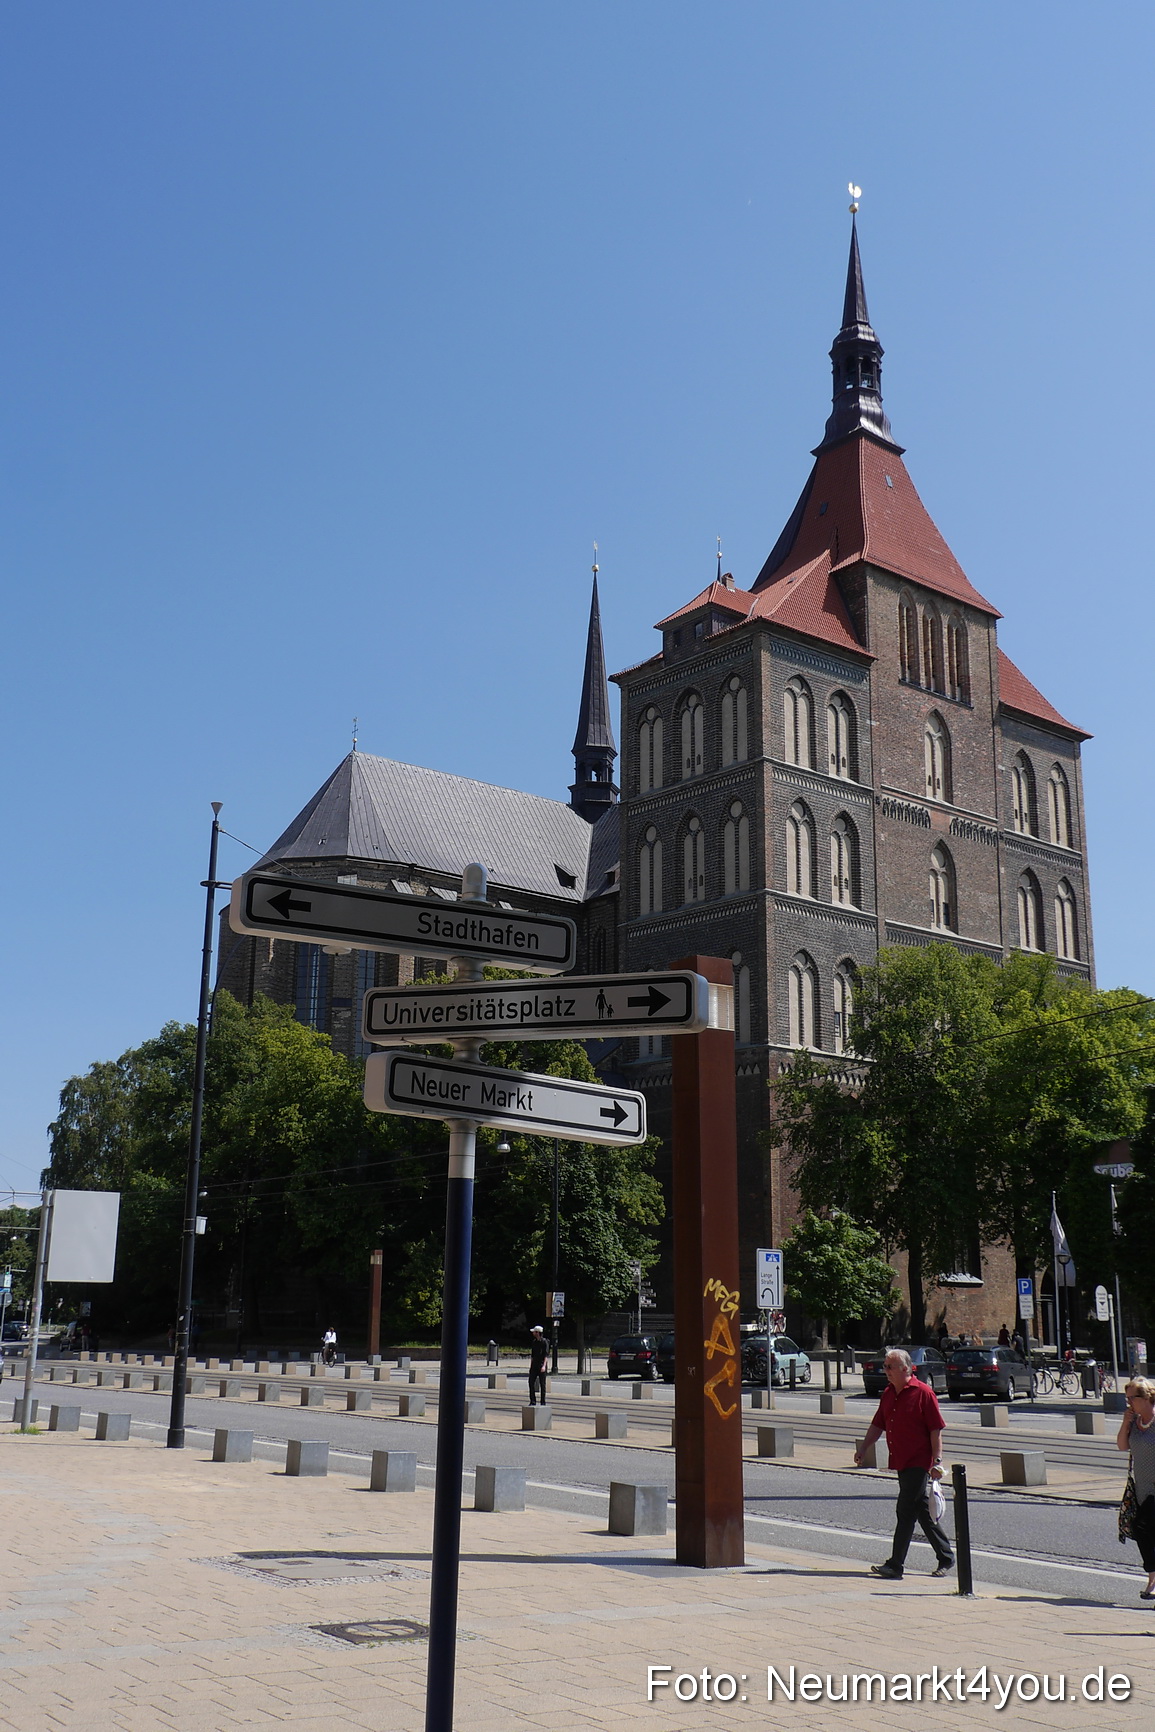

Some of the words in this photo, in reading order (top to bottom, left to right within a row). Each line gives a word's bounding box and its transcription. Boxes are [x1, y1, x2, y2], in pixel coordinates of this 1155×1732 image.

[417, 912, 539, 950] Stadthafen
[383, 995, 576, 1025] Universitätsplatz
[410, 1070, 471, 1102] Neuer
[480, 1081, 533, 1112] Markt
[1021, 1280, 1029, 1293] P
